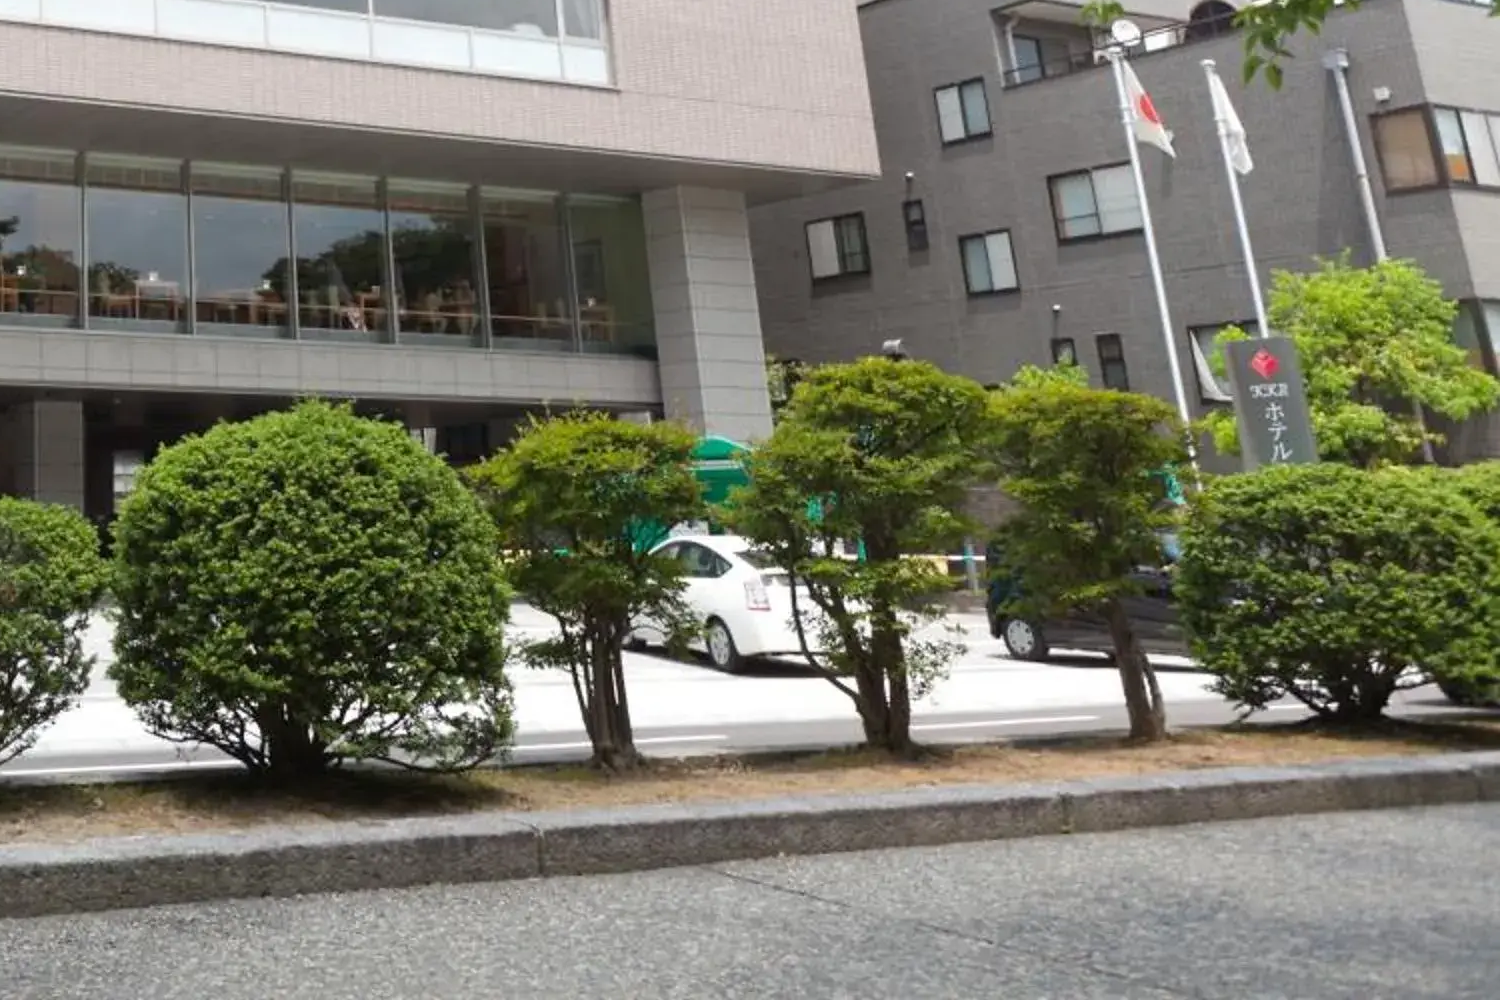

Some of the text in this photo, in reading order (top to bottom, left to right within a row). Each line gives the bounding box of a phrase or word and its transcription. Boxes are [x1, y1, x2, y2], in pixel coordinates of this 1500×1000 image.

[1249, 383, 1289, 398] KKR
[1265, 402, 1294, 463] ホテル
